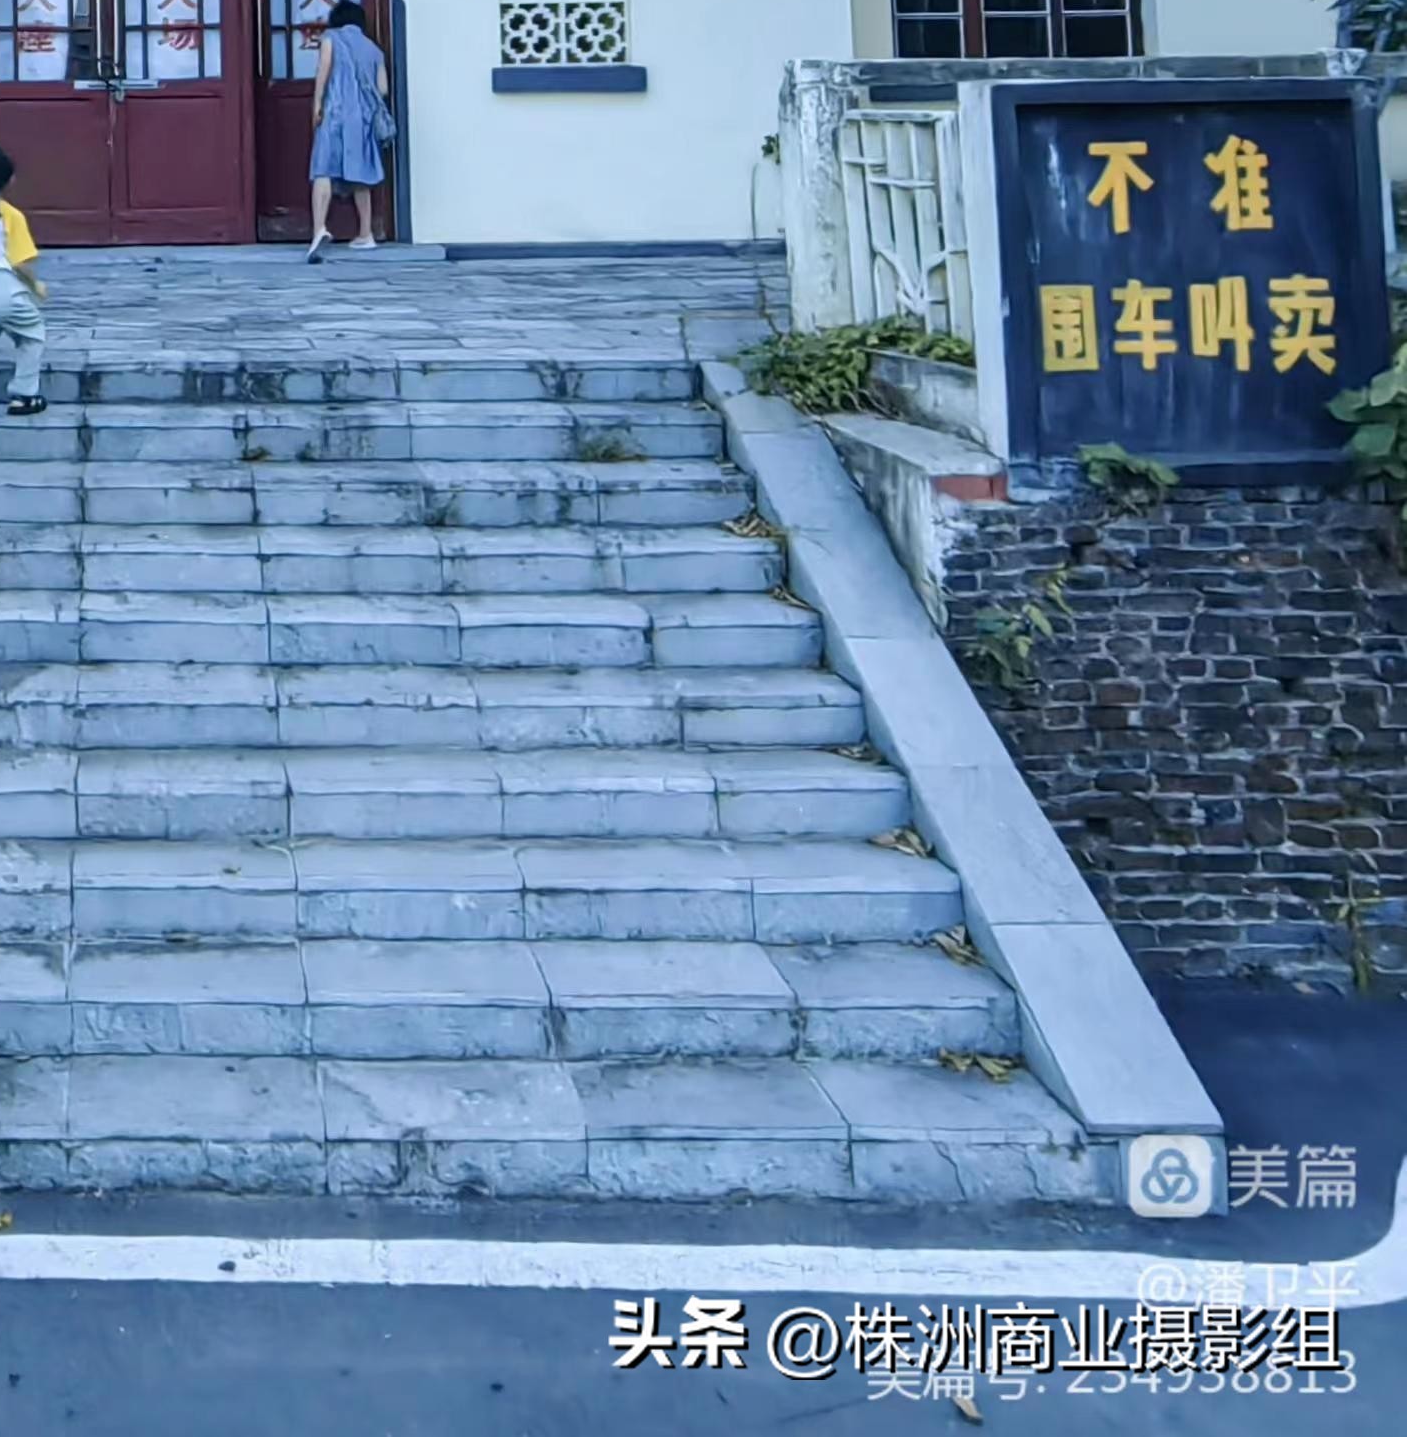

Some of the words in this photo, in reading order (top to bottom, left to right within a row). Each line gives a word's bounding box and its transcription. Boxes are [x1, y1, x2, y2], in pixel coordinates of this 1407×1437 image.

[1087, 134, 1274, 234] 不准
[1039, 275, 1337, 374] 围车叫卖
